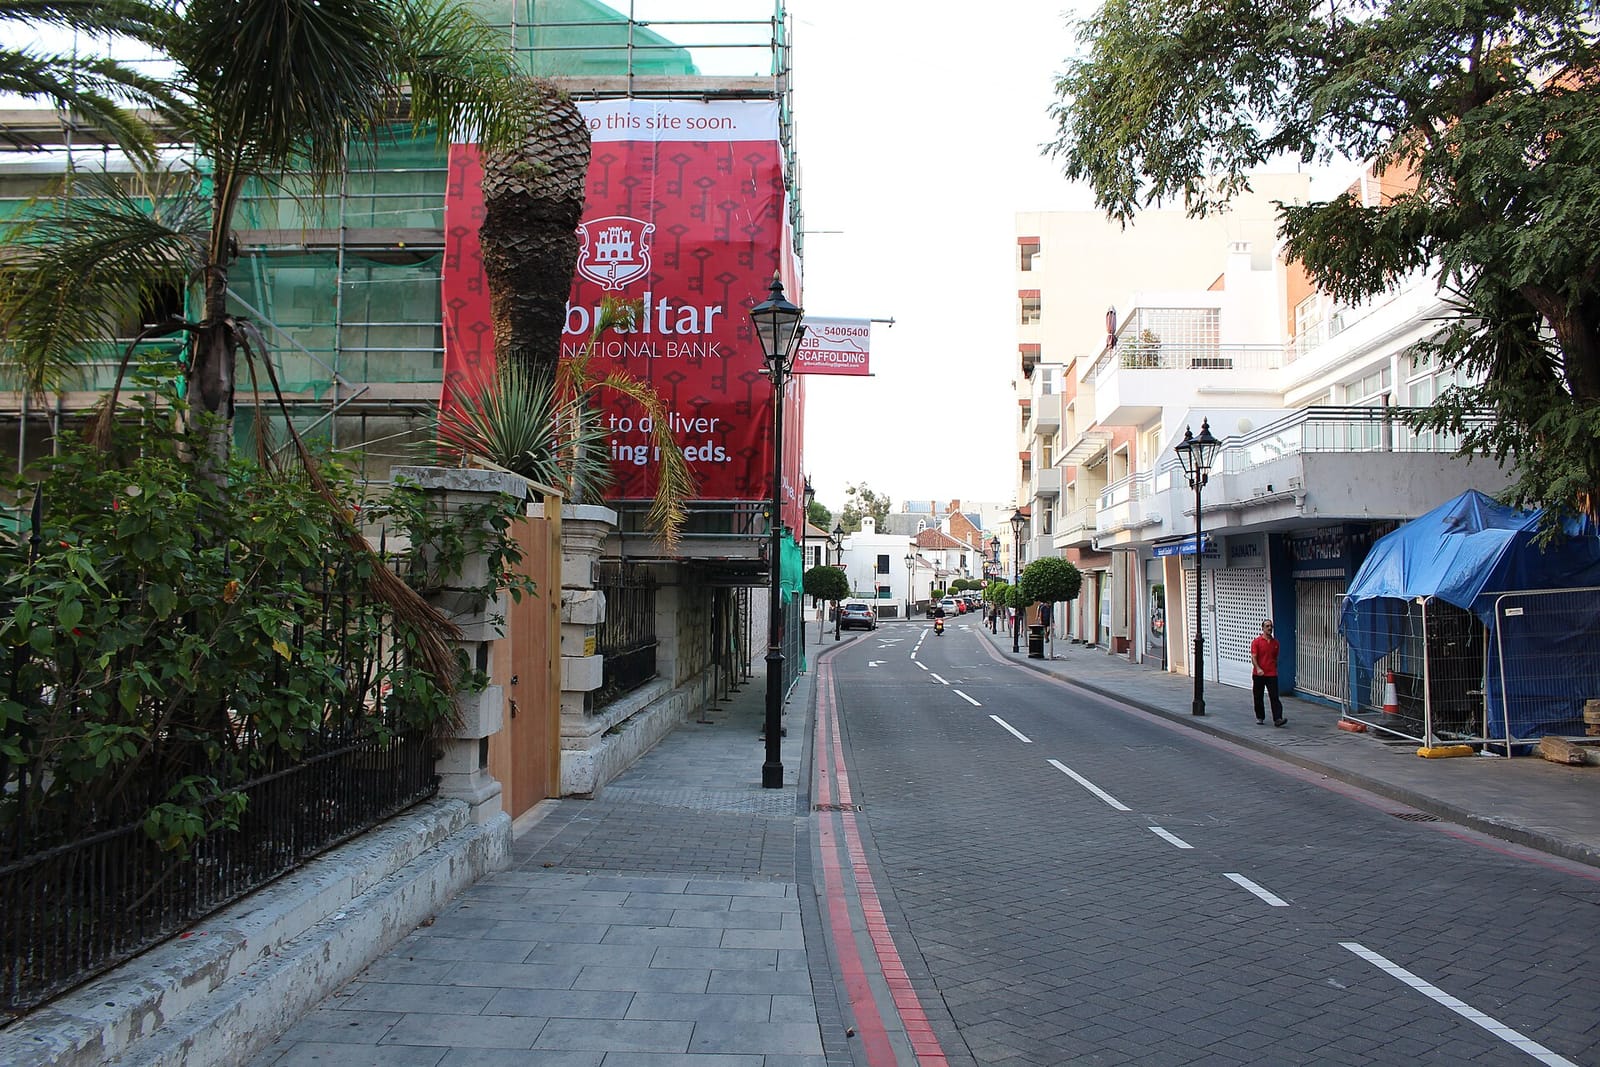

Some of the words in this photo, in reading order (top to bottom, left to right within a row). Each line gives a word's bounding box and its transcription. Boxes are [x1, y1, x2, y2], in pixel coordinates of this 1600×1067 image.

[607, 112, 640, 129] this
[646, 113, 681, 129] site
[686, 116, 737, 129] soon.
[824, 326, 869, 337] 54005400
[667, 341, 721, 358] BANK
[800, 338, 820, 348] GIB
[798, 350, 865, 363] SCAFFOLDING
[608, 413, 633, 433] to
[639, 412, 720, 433] dliver
